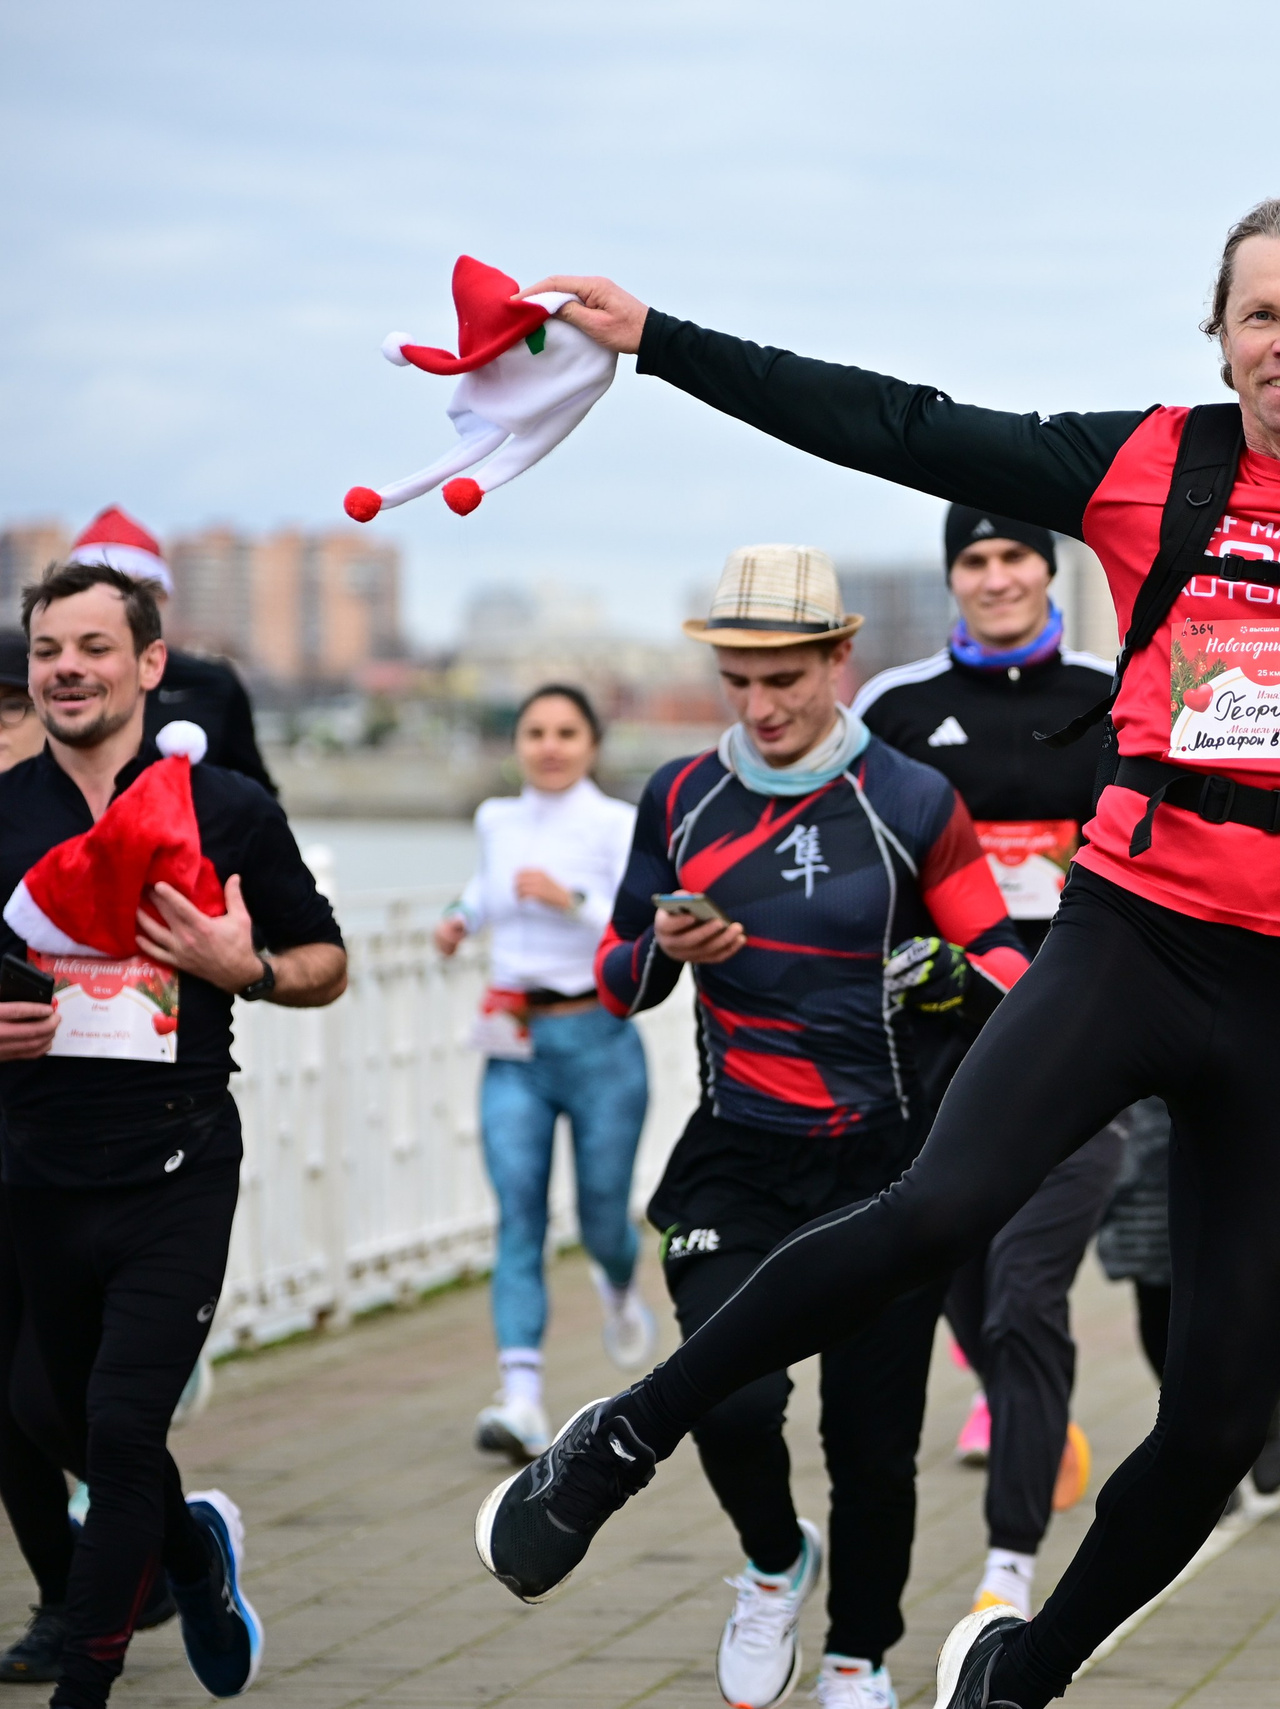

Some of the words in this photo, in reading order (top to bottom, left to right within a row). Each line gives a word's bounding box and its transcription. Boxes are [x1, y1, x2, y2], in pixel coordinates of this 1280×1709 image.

[1190, 623, 1214, 636] 364
[1257, 669, 1268, 677] 25
[1187, 730, 1265, 752] Марафон
[1270, 731, 1280, 747] в
[773, 823, 831, 900] 隼
